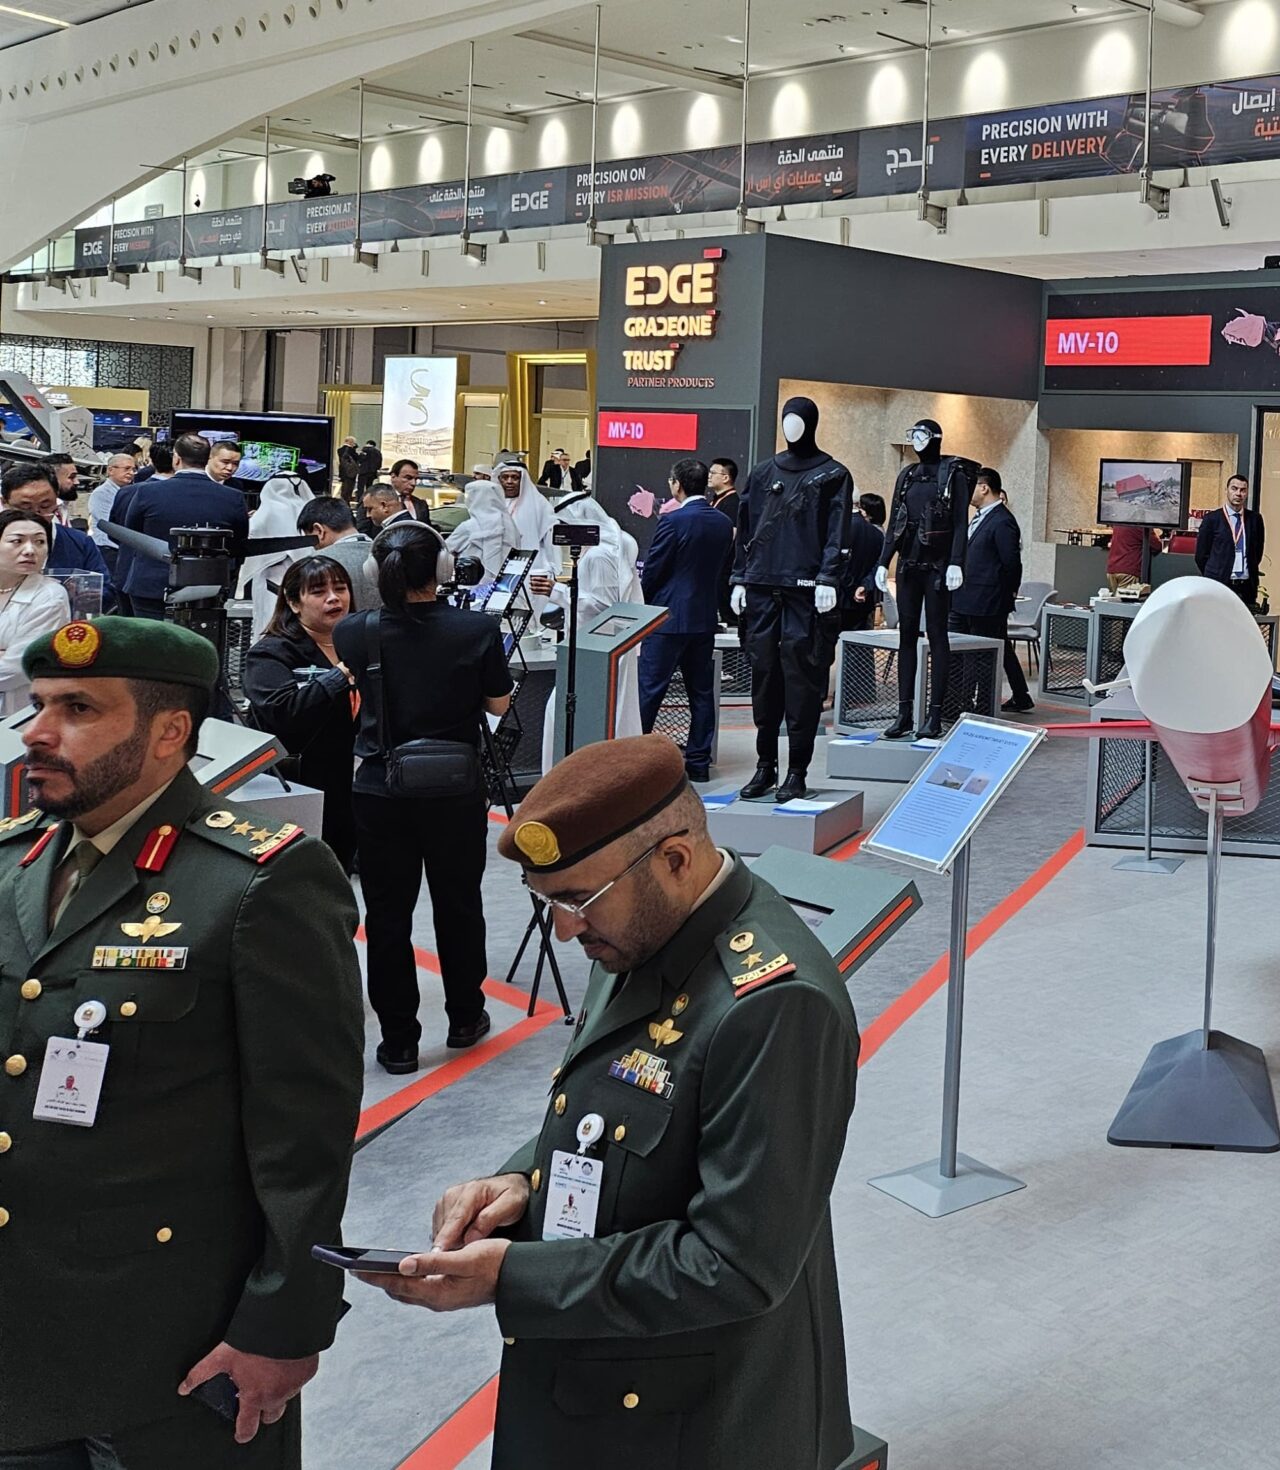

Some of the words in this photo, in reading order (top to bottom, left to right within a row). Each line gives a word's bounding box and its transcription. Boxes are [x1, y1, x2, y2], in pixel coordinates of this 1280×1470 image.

[1232, 88, 1276, 115] إيصال
[982, 115, 1062, 141] PRECISION
[1066, 110, 1108, 131] WITH
[778, 149, 805, 165] الدقة
[807, 144, 844, 161] منتهى
[980, 144, 1028, 165] EVERY
[1031, 135, 1107, 160] DELIVERY
[576, 169, 628, 187] PRECISION
[629, 167, 646, 181] ON
[824, 166, 843, 187] في
[511, 190, 549, 212] EDGE
[607, 188, 623, 203] ISR
[625, 185, 669, 201] MISSION
[306, 203, 342, 219] PRECISION
[342, 202, 352, 214] AT
[114, 227, 140, 239] PRECISION
[140, 225, 154, 237] WITH
[306, 221, 327, 234] EVERY
[83, 241, 103, 256] EDGE
[625, 262, 715, 306] EDGE
[624, 314, 713, 338] GRADEONE
[1057, 331, 1119, 354] MV-10
[623, 350, 675, 371] TRUST
[627, 377, 666, 388] PARTNER
[667, 377, 715, 389] PRODUCTS
[608, 421, 644, 440] MV-10
